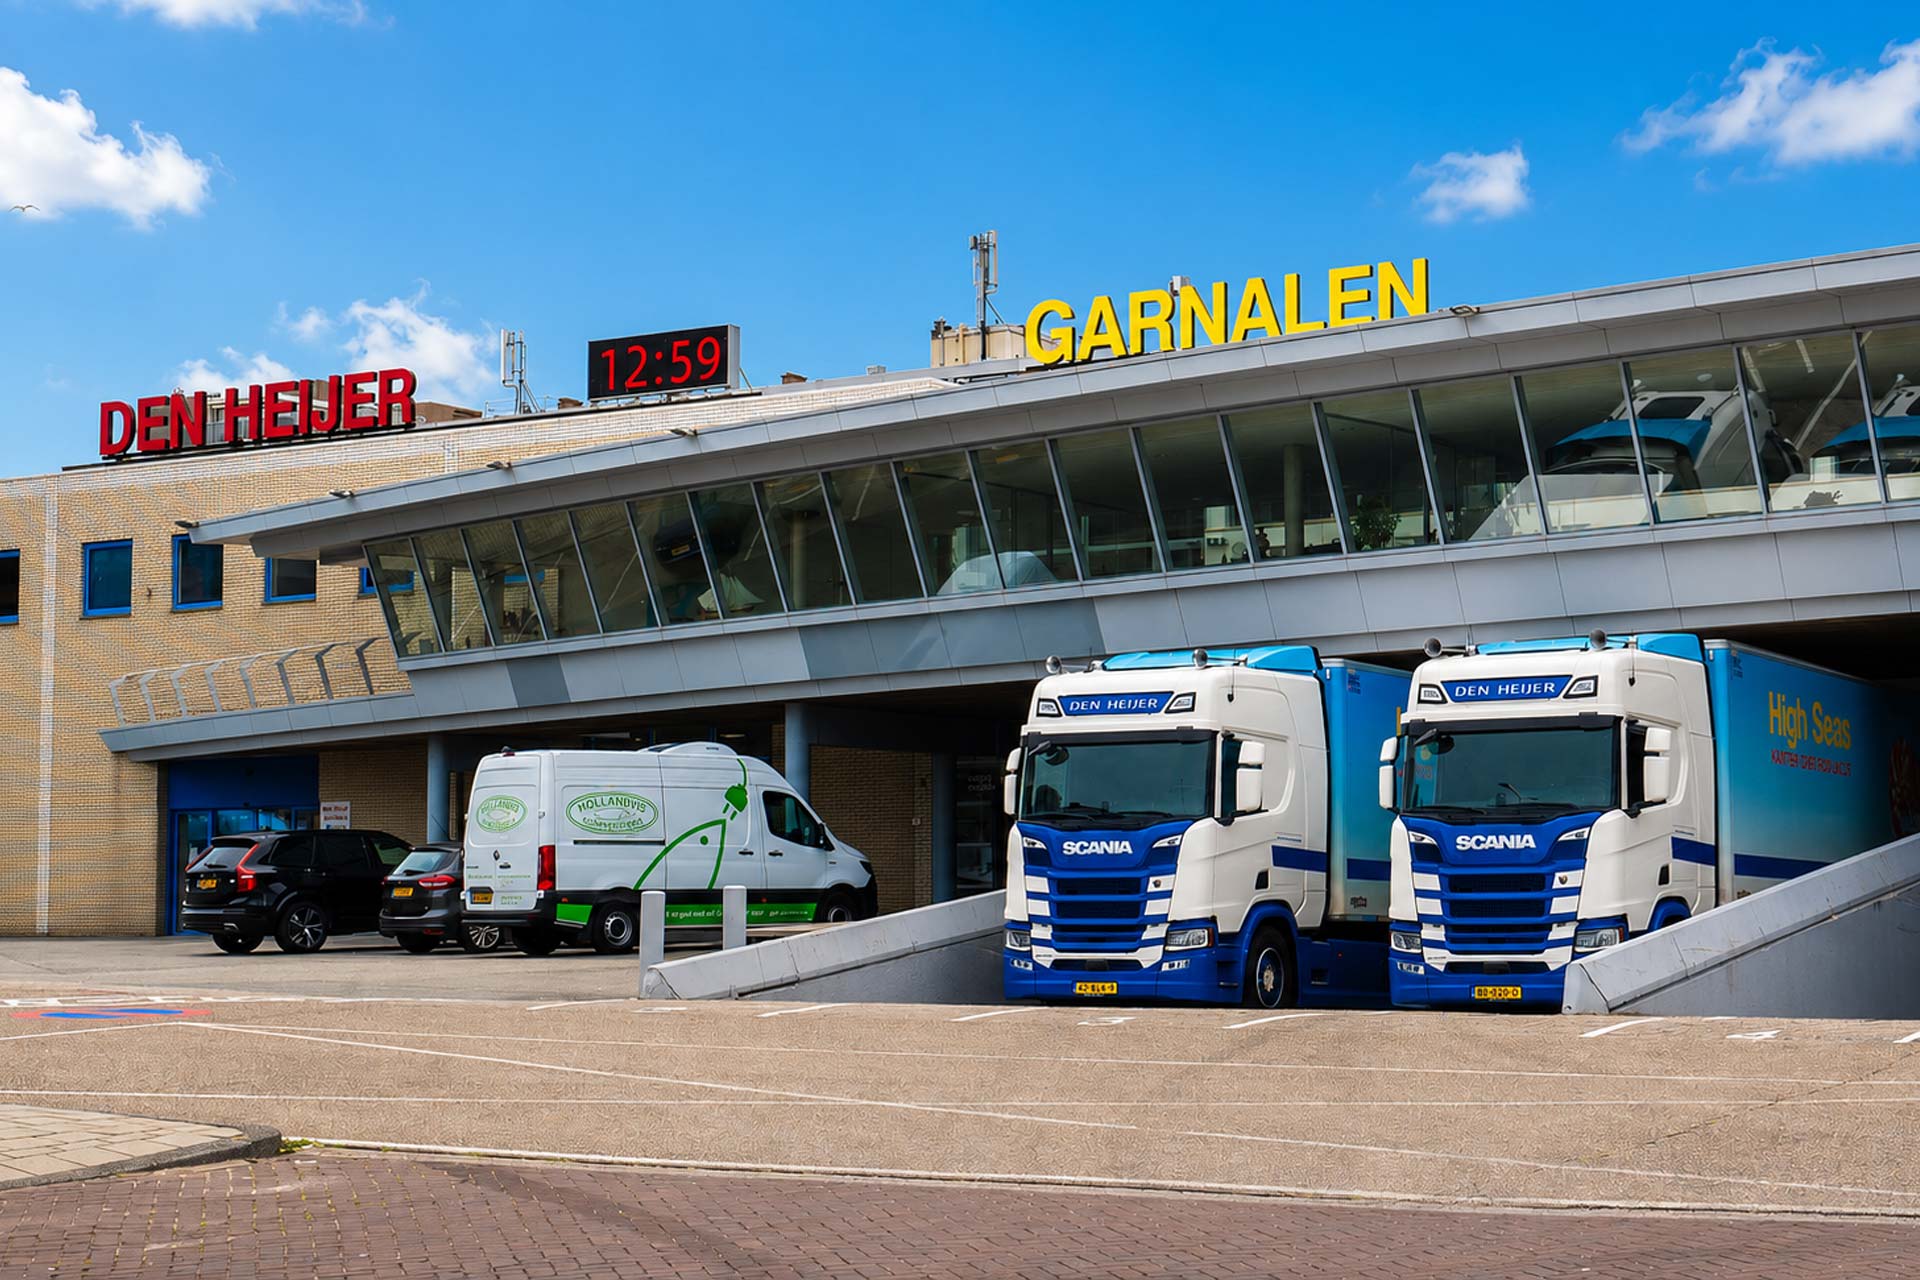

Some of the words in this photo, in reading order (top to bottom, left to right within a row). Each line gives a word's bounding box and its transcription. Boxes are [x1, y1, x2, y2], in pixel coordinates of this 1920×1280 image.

[1025, 257, 1429, 365] GARNALEN
[601, 336, 721, 391] 12:59
[100, 391, 207, 456] DEN
[224, 368, 416, 444] HEIJER
[1455, 685, 1489, 697] DEN
[1498, 682, 1555, 695] HEIJER
[1069, 700, 1100, 711] DEN
[1107, 698, 1158, 710] HEIJER
[1768, 690, 1808, 750] High
[1812, 701, 1852, 750] Seas
[577, 796, 647, 813] HOLLANDVIS
[1062, 840, 1134, 856] SCANIA
[1456, 834, 1537, 851] SCANIA
